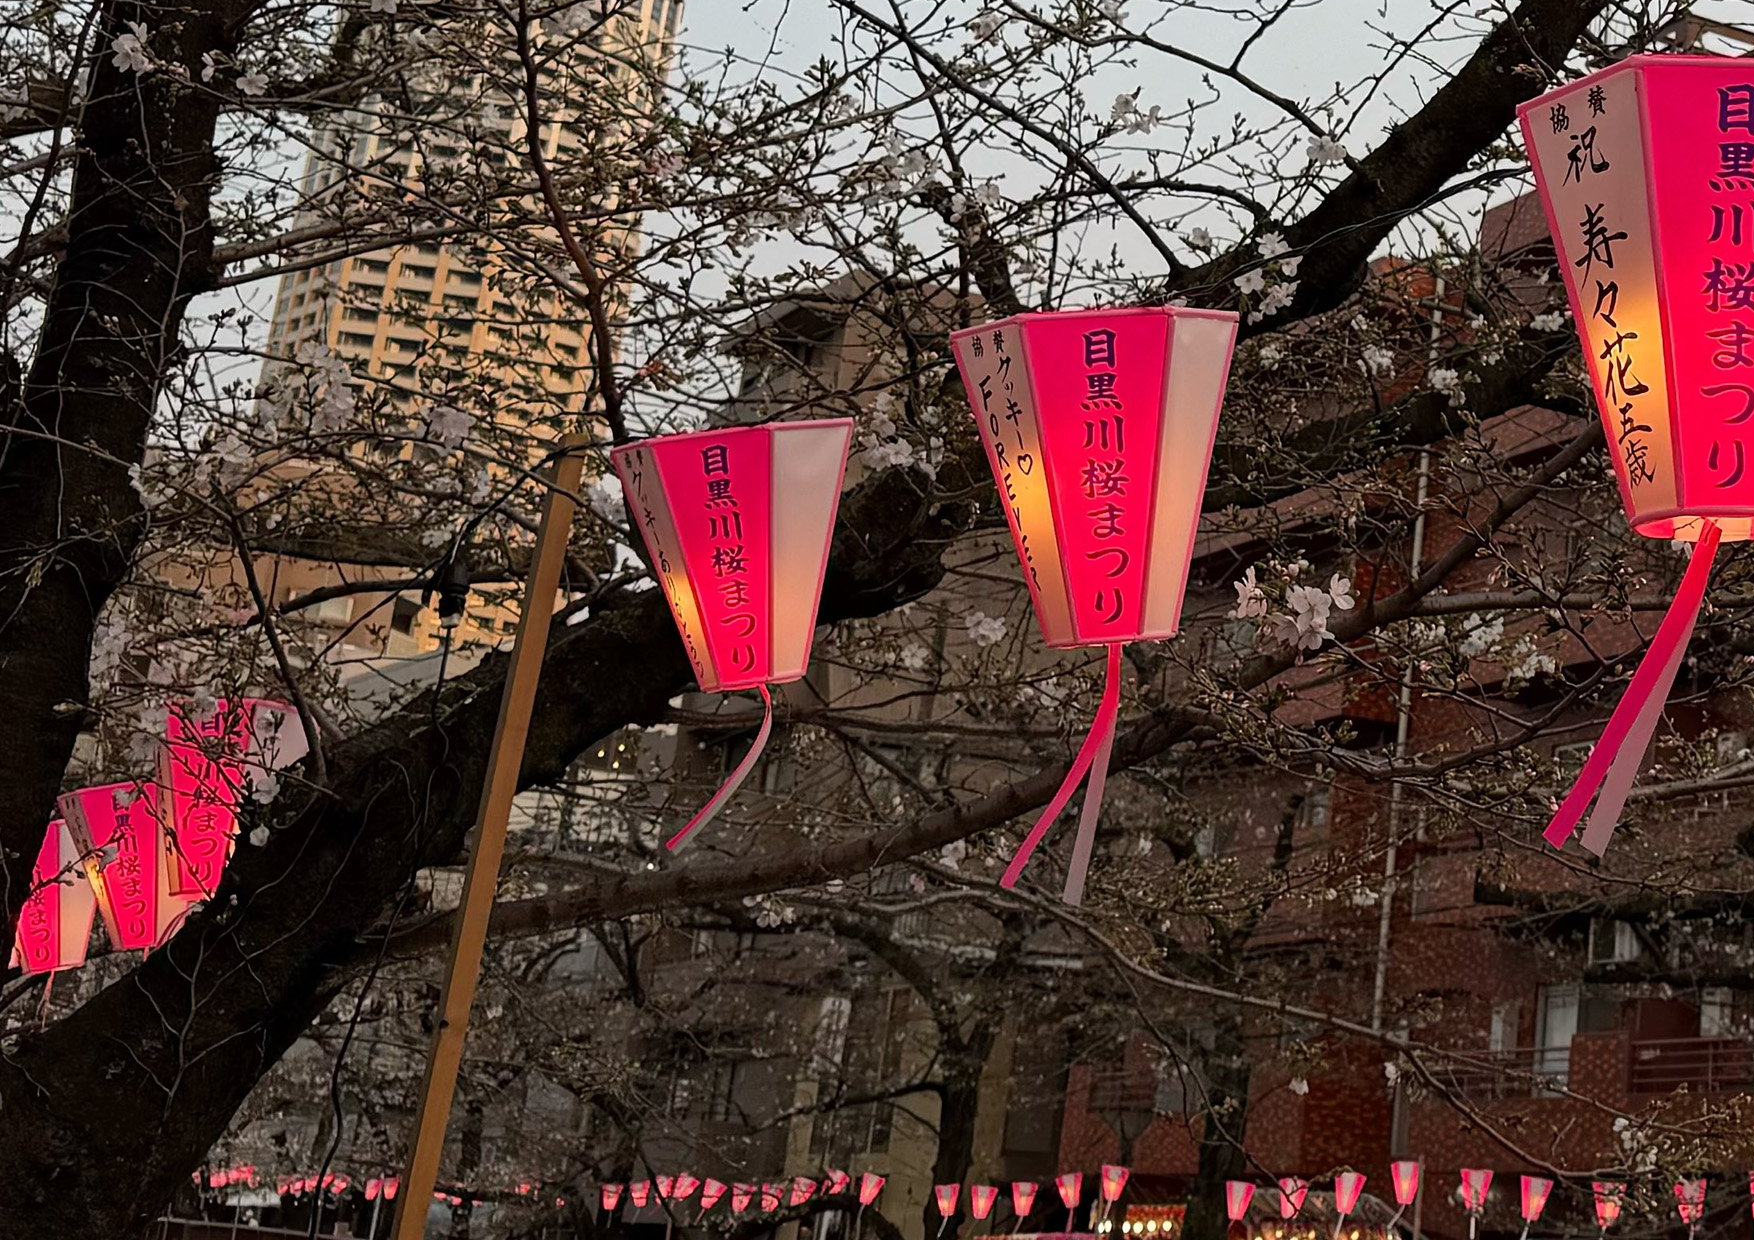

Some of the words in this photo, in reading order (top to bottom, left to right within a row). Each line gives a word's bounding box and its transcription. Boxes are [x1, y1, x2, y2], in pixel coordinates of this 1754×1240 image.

[1549, 86, 1609, 135] 協賛
[700, 444, 758, 674] 目黒川桜まつり
[1079, 327, 1131, 625] 目黒川桜まつり
